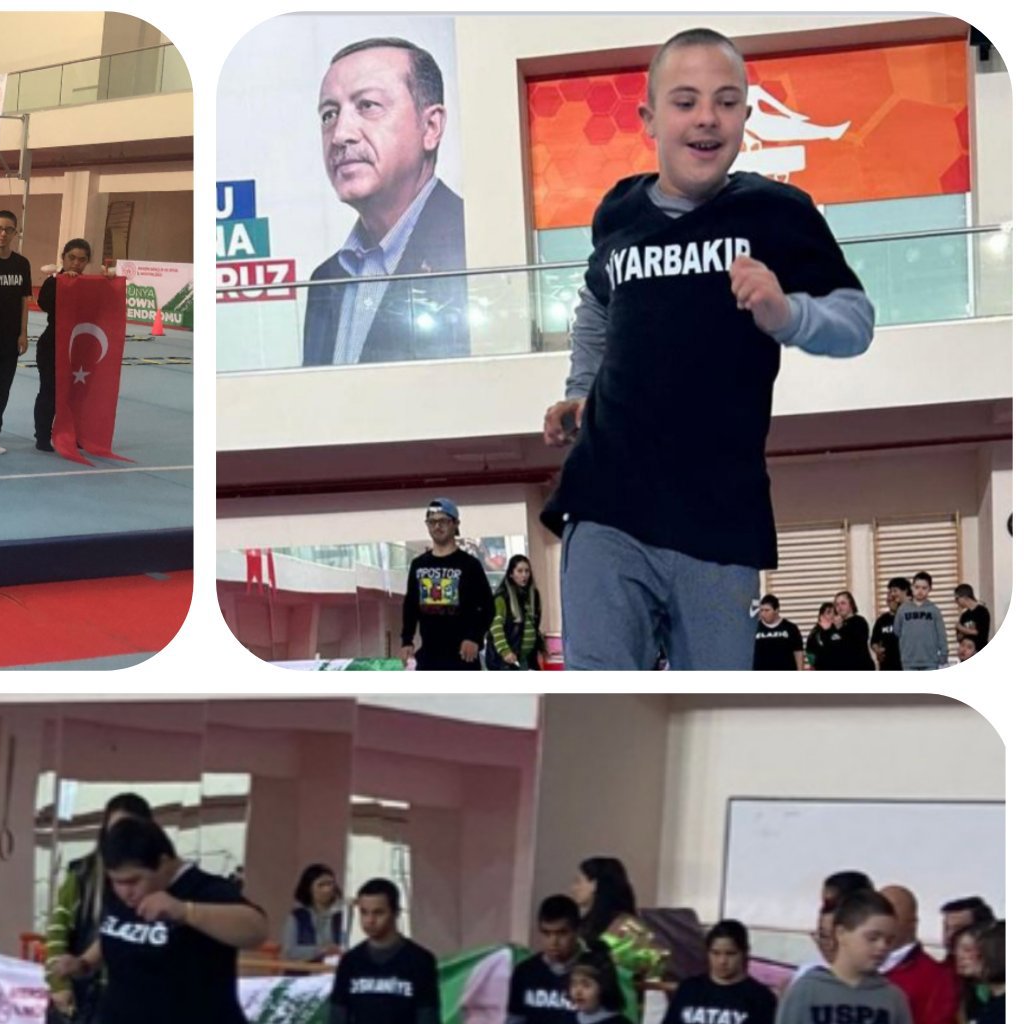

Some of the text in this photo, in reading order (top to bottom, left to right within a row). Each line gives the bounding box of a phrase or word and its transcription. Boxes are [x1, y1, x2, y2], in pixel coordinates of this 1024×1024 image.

[128, 284, 155, 298] ÜNYA
[126, 298, 156, 309] OWN
[904, 611, 933, 621] USPA
